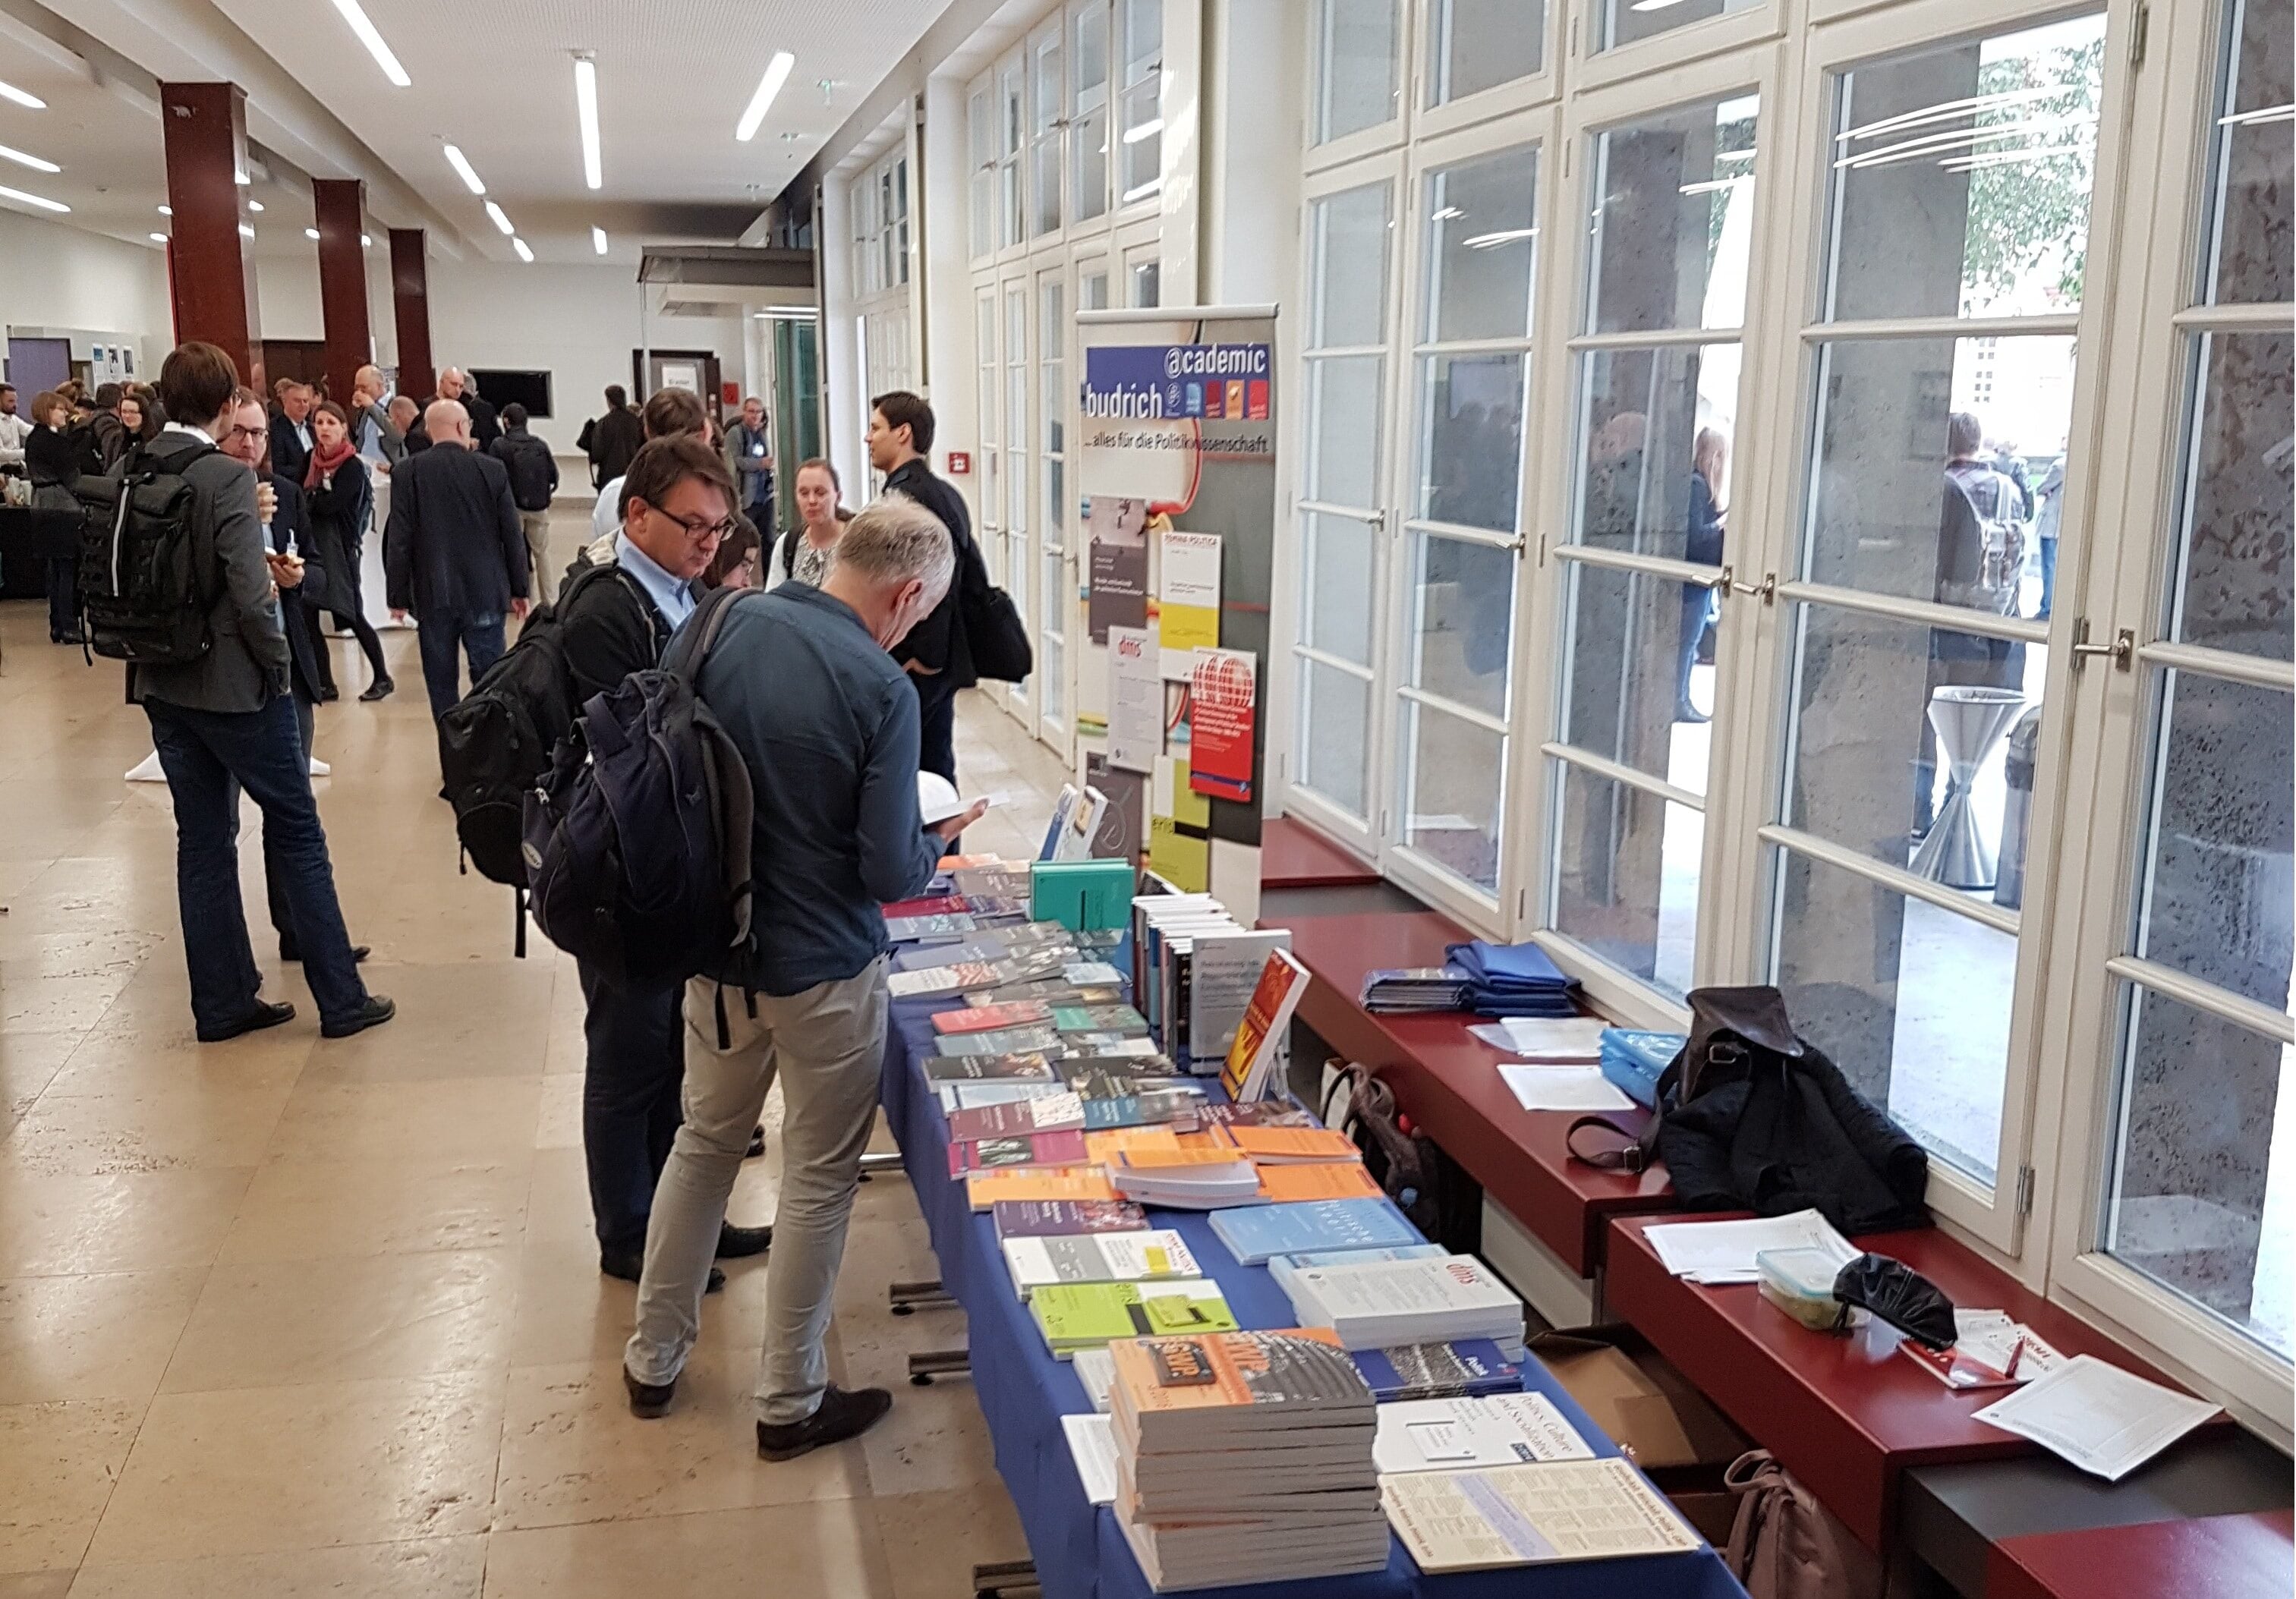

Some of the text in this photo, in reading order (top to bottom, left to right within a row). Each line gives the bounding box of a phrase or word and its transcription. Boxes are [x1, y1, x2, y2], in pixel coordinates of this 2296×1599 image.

[1164, 342, 1267, 379] @cademic
[1085, 381, 1163, 420] budrich
[1117, 430, 1134, 449] für
[1135, 431, 1154, 450] die
[1154, 431, 1269, 454] Politikwissenschaft
